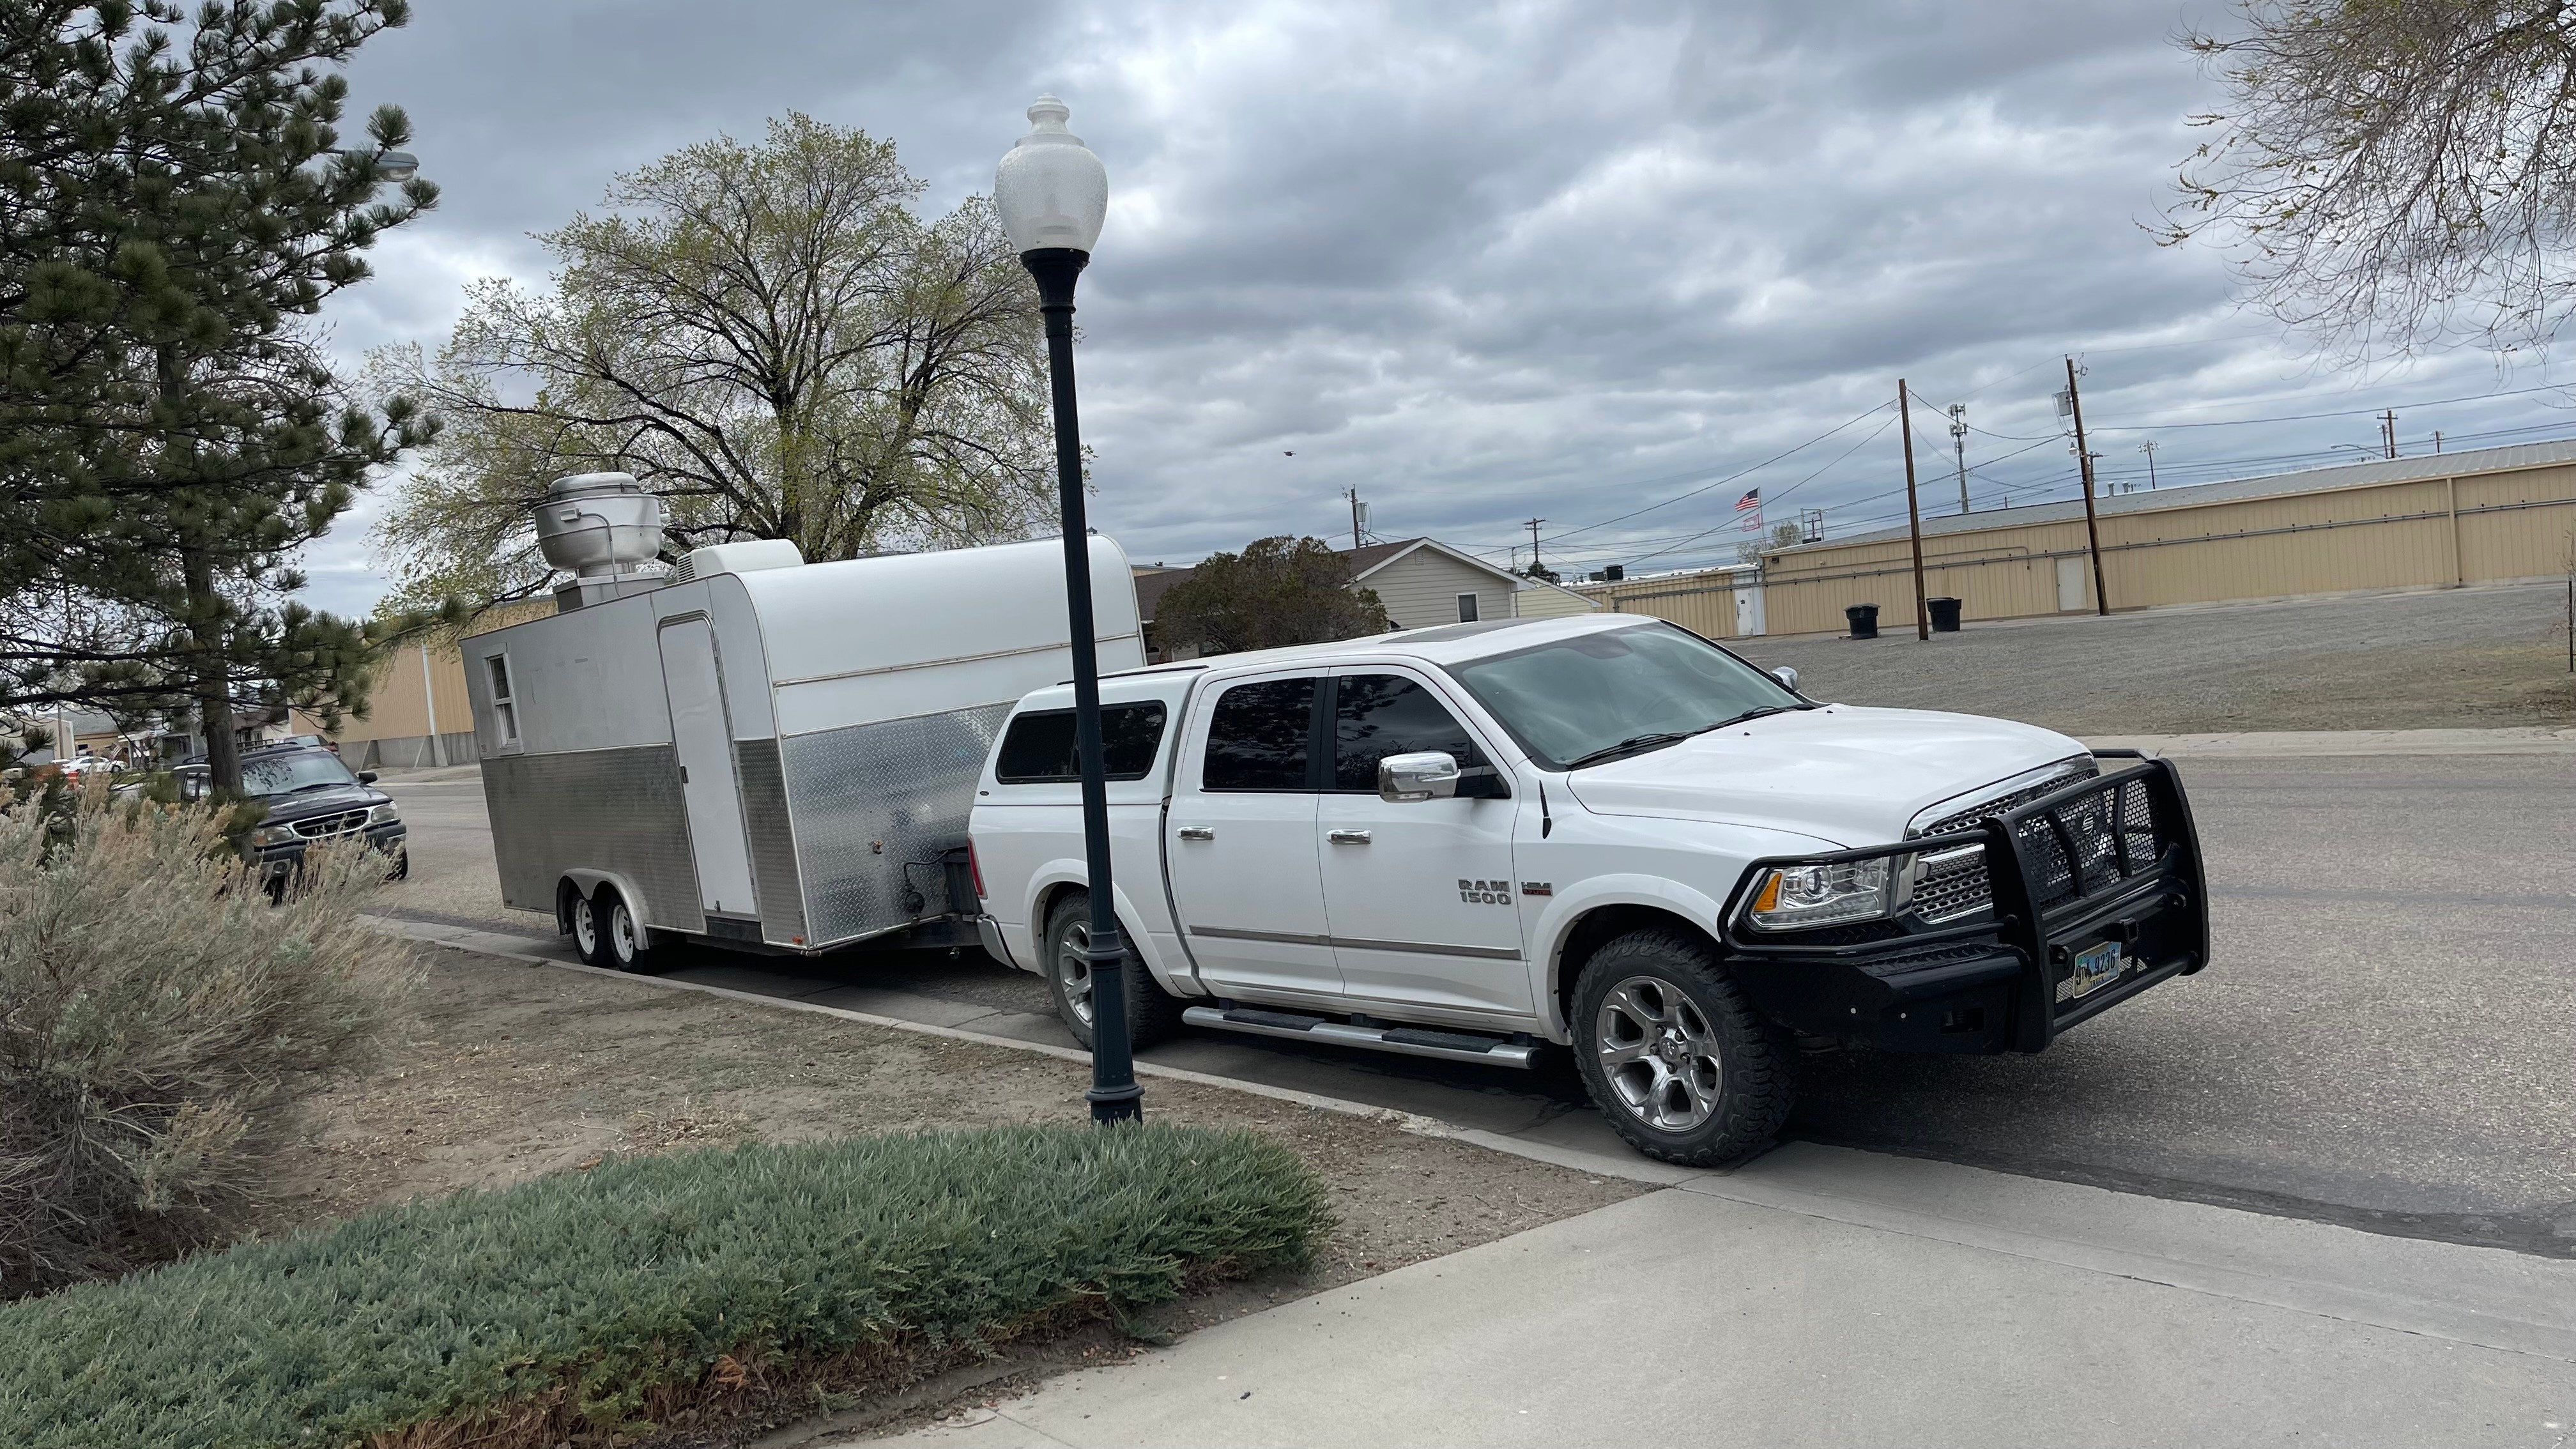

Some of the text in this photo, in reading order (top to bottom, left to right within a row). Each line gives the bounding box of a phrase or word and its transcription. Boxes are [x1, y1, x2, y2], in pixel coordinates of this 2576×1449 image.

[1458, 879, 1510, 892] RAM
[1460, 891, 1511, 905] 1500
[2095, 949, 2115, 976] 9236
